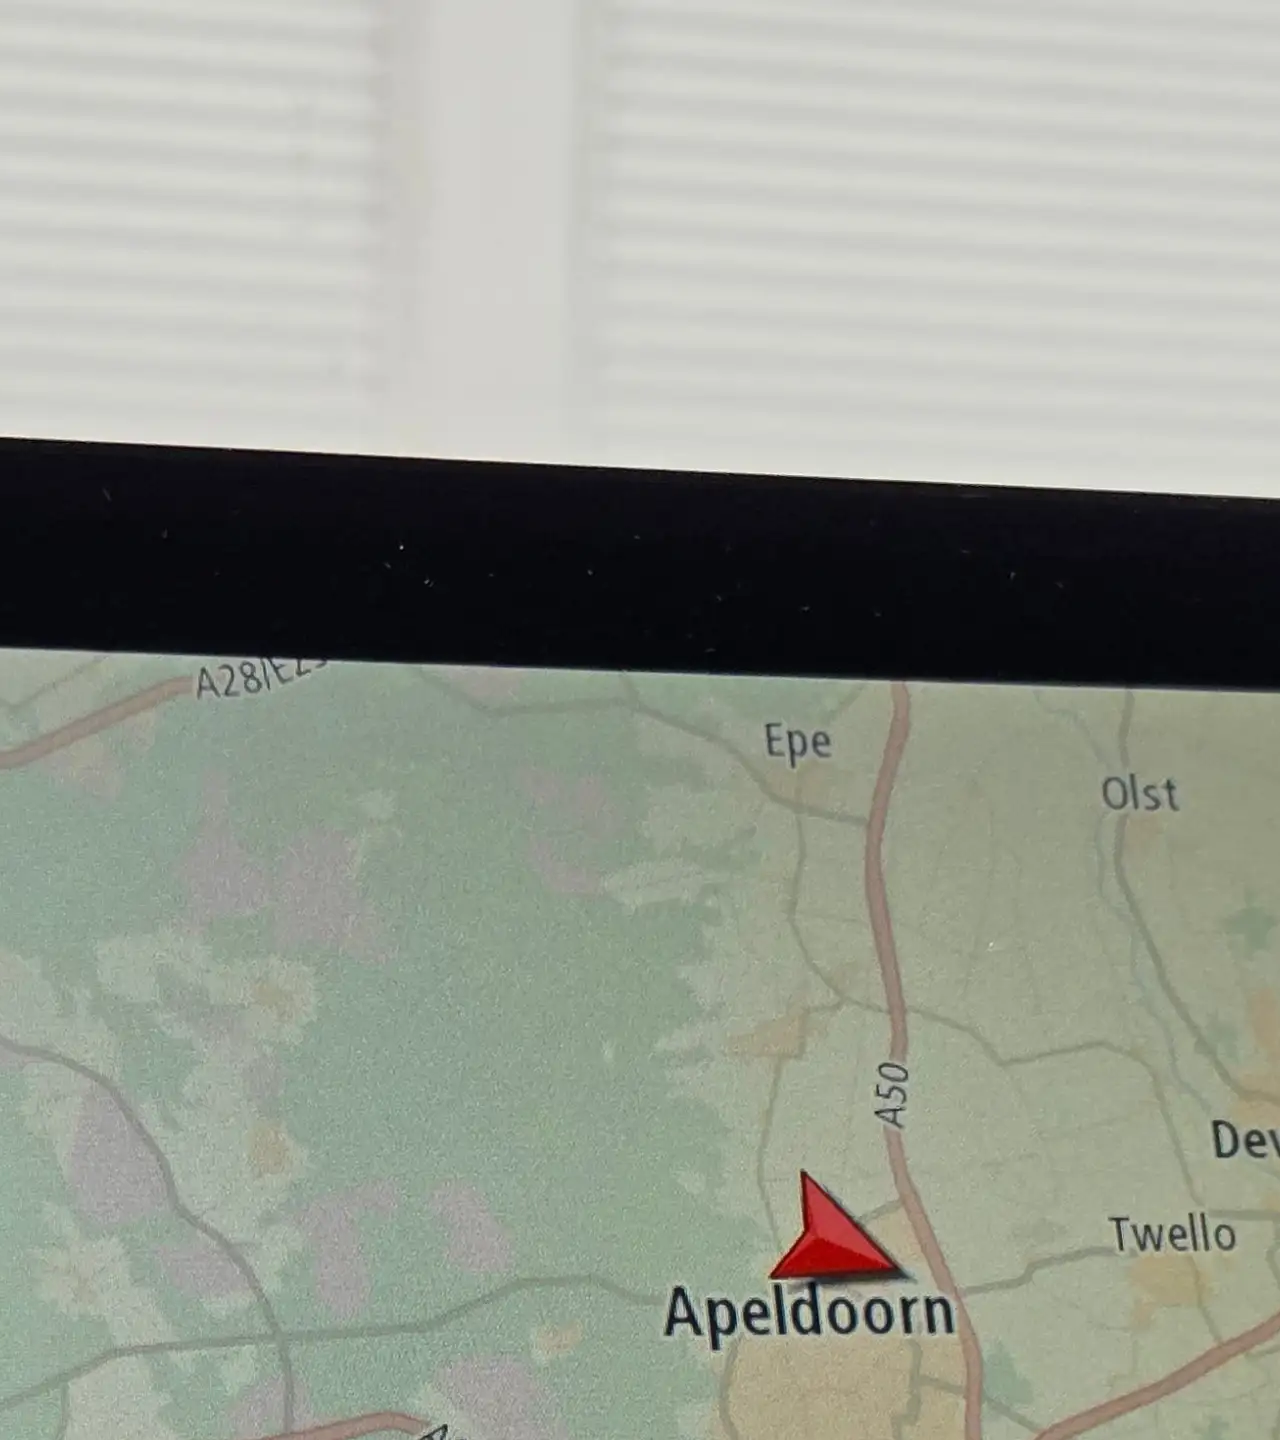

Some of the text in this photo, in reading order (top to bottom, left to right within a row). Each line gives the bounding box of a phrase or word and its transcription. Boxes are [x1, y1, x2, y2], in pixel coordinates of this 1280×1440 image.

[765, 722, 832, 768] Epe
[1102, 776, 1180, 812] Olst
[875, 1062, 908, 1128] A50
[1109, 1213, 1236, 1254] Twello
[664, 1283, 956, 1350] Apeldoorn
